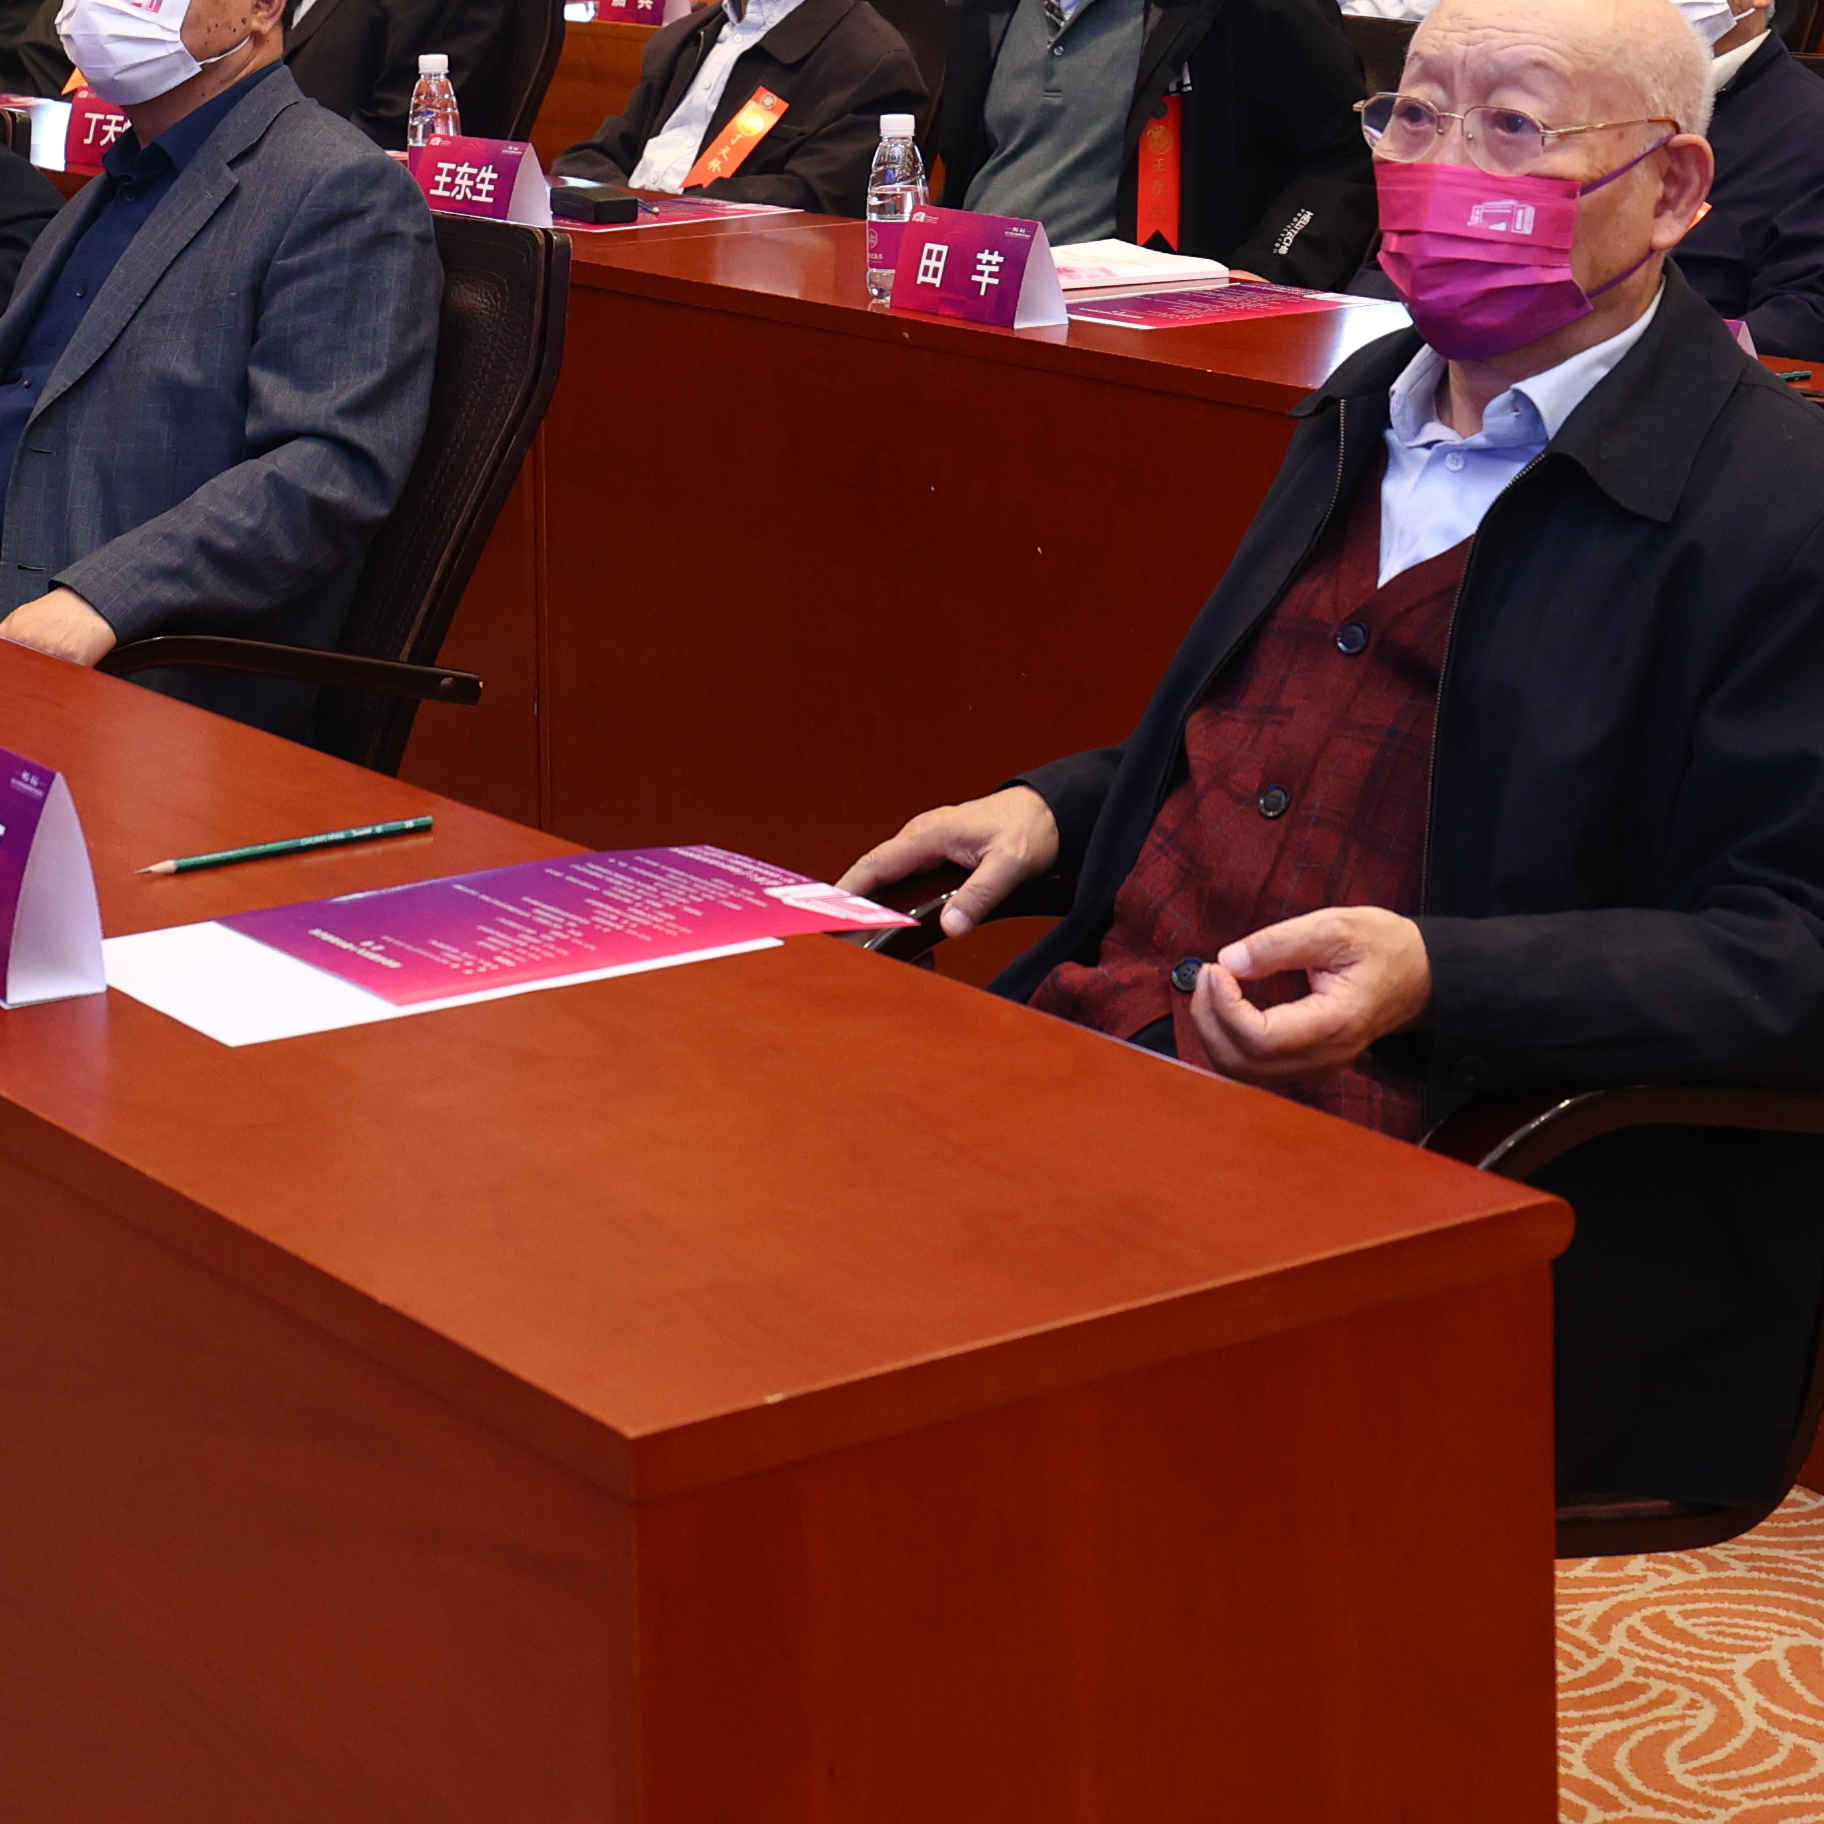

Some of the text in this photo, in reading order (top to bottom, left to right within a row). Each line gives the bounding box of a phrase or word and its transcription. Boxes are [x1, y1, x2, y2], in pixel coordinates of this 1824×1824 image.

[429, 161, 499, 204] 王东生
[916, 242, 1005, 296] 田芊
